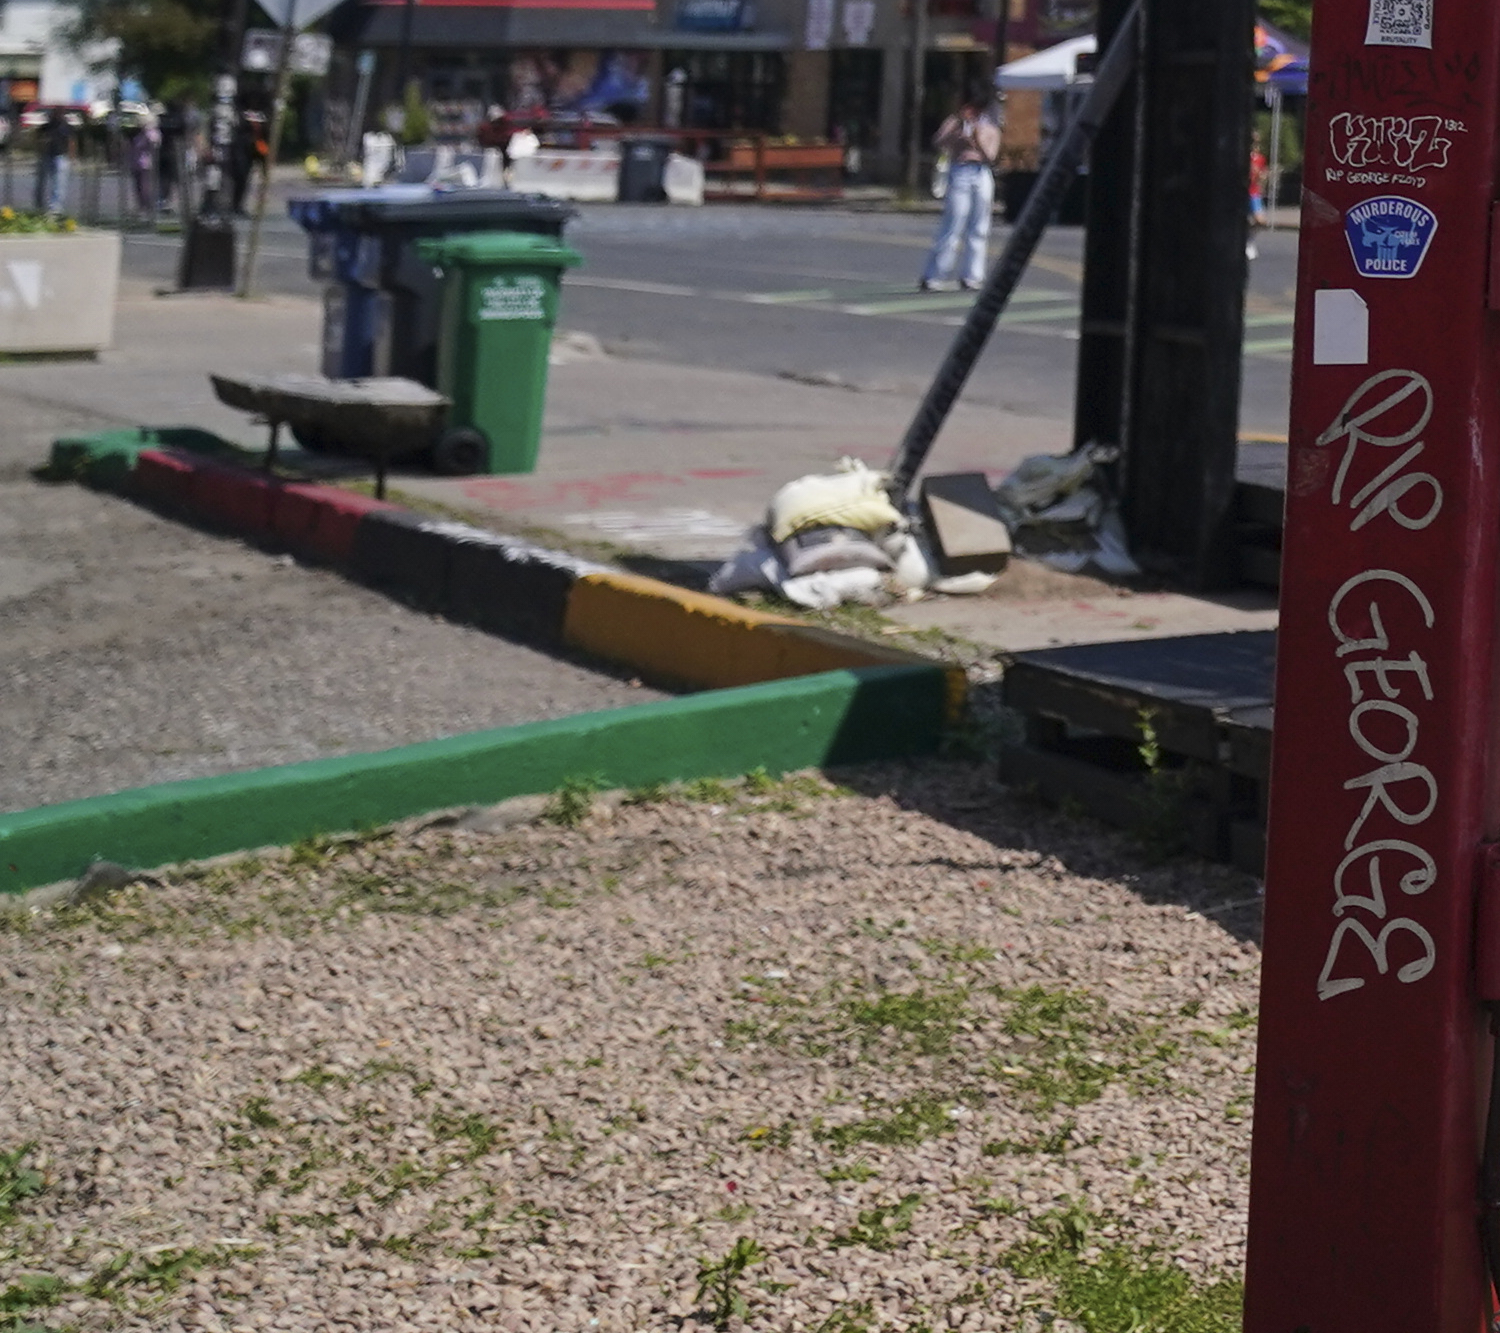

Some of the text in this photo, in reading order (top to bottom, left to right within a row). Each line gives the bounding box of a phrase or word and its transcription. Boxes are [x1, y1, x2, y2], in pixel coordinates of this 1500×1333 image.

[1346, 171, 1390, 185] GEORGE
[1350, 199, 1430, 228] MURDEROUS
[1364, 257, 1408, 273] POLICE
[1316, 368, 1443, 531] RIP
[1317, 569, 1437, 1001] GEORGE
